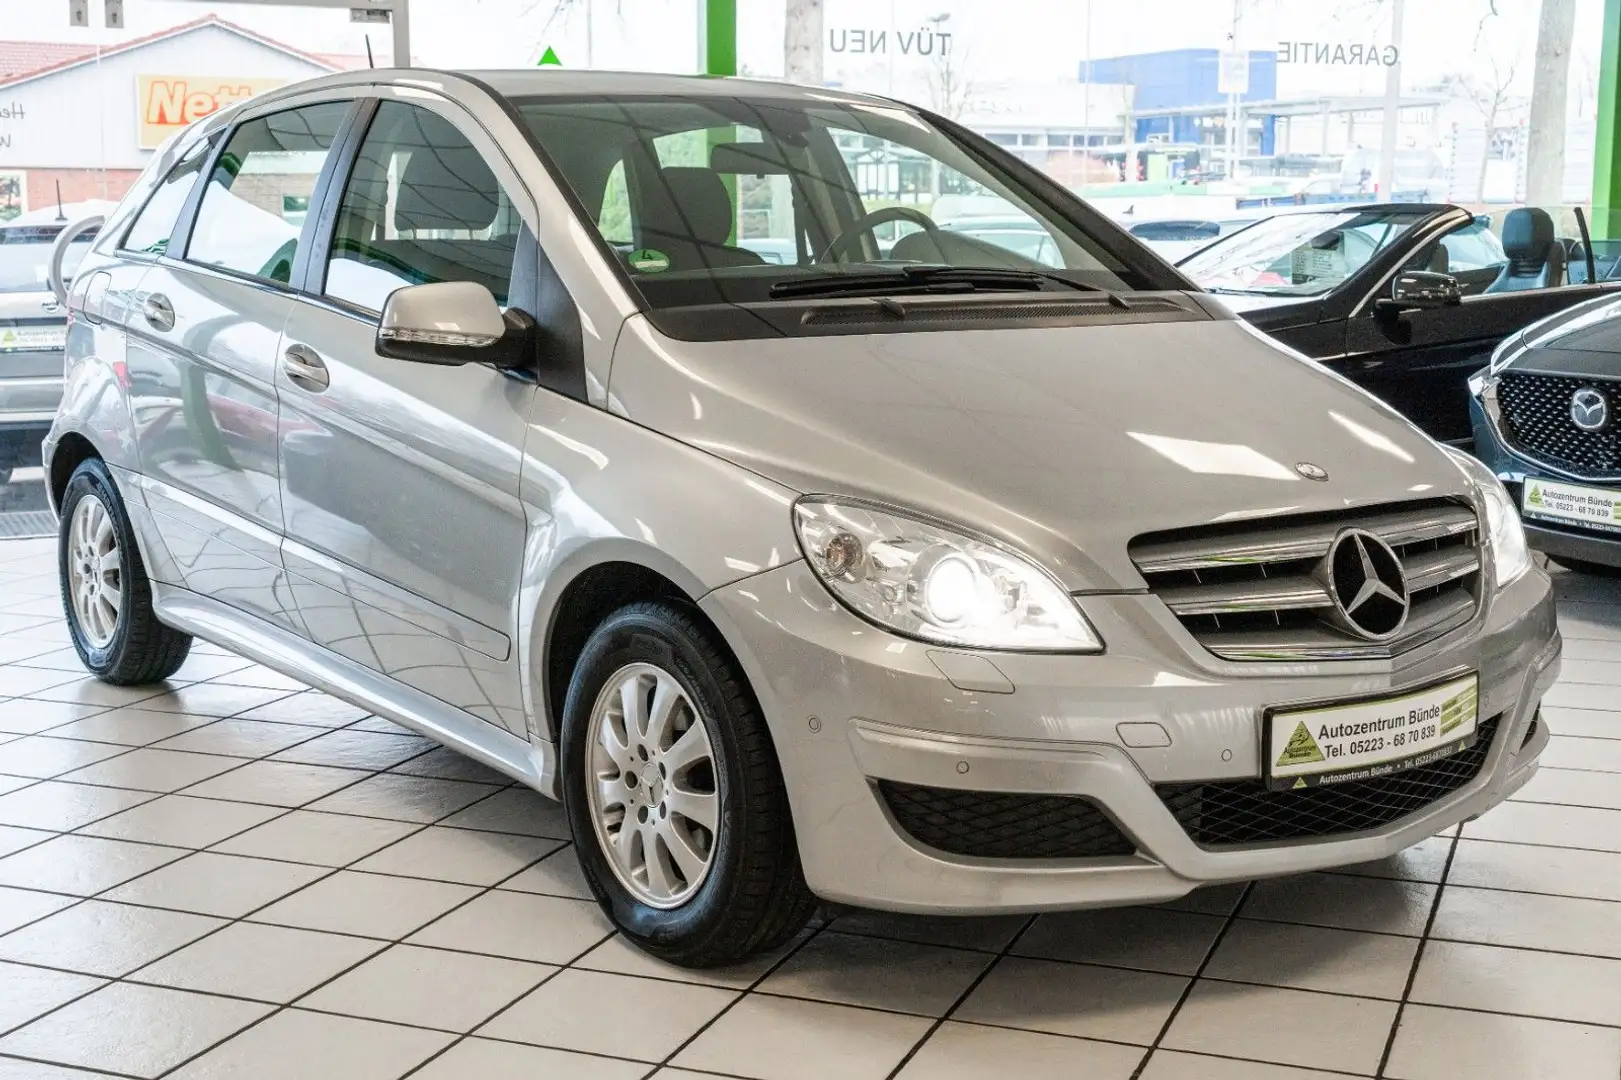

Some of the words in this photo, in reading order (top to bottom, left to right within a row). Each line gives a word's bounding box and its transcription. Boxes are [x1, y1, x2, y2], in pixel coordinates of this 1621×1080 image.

[1542, 489, 1586, 503] Autozentrum
[1587, 495, 1613, 508] Bünde
[1318, 714, 1406, 740] Autozentrum
[1408, 704, 1440, 726] Bünde
[1324, 743, 1346, 758] Tel.
[1350, 737, 1384, 755] 05223
[1393, 733, 1405, 748] 68
[1408, 730, 1419, 743] 70
[1420, 724, 1436, 740] 839
[1319, 769, 1370, 785] Autozentrum
[1370, 764, 1393, 777] Bünde
